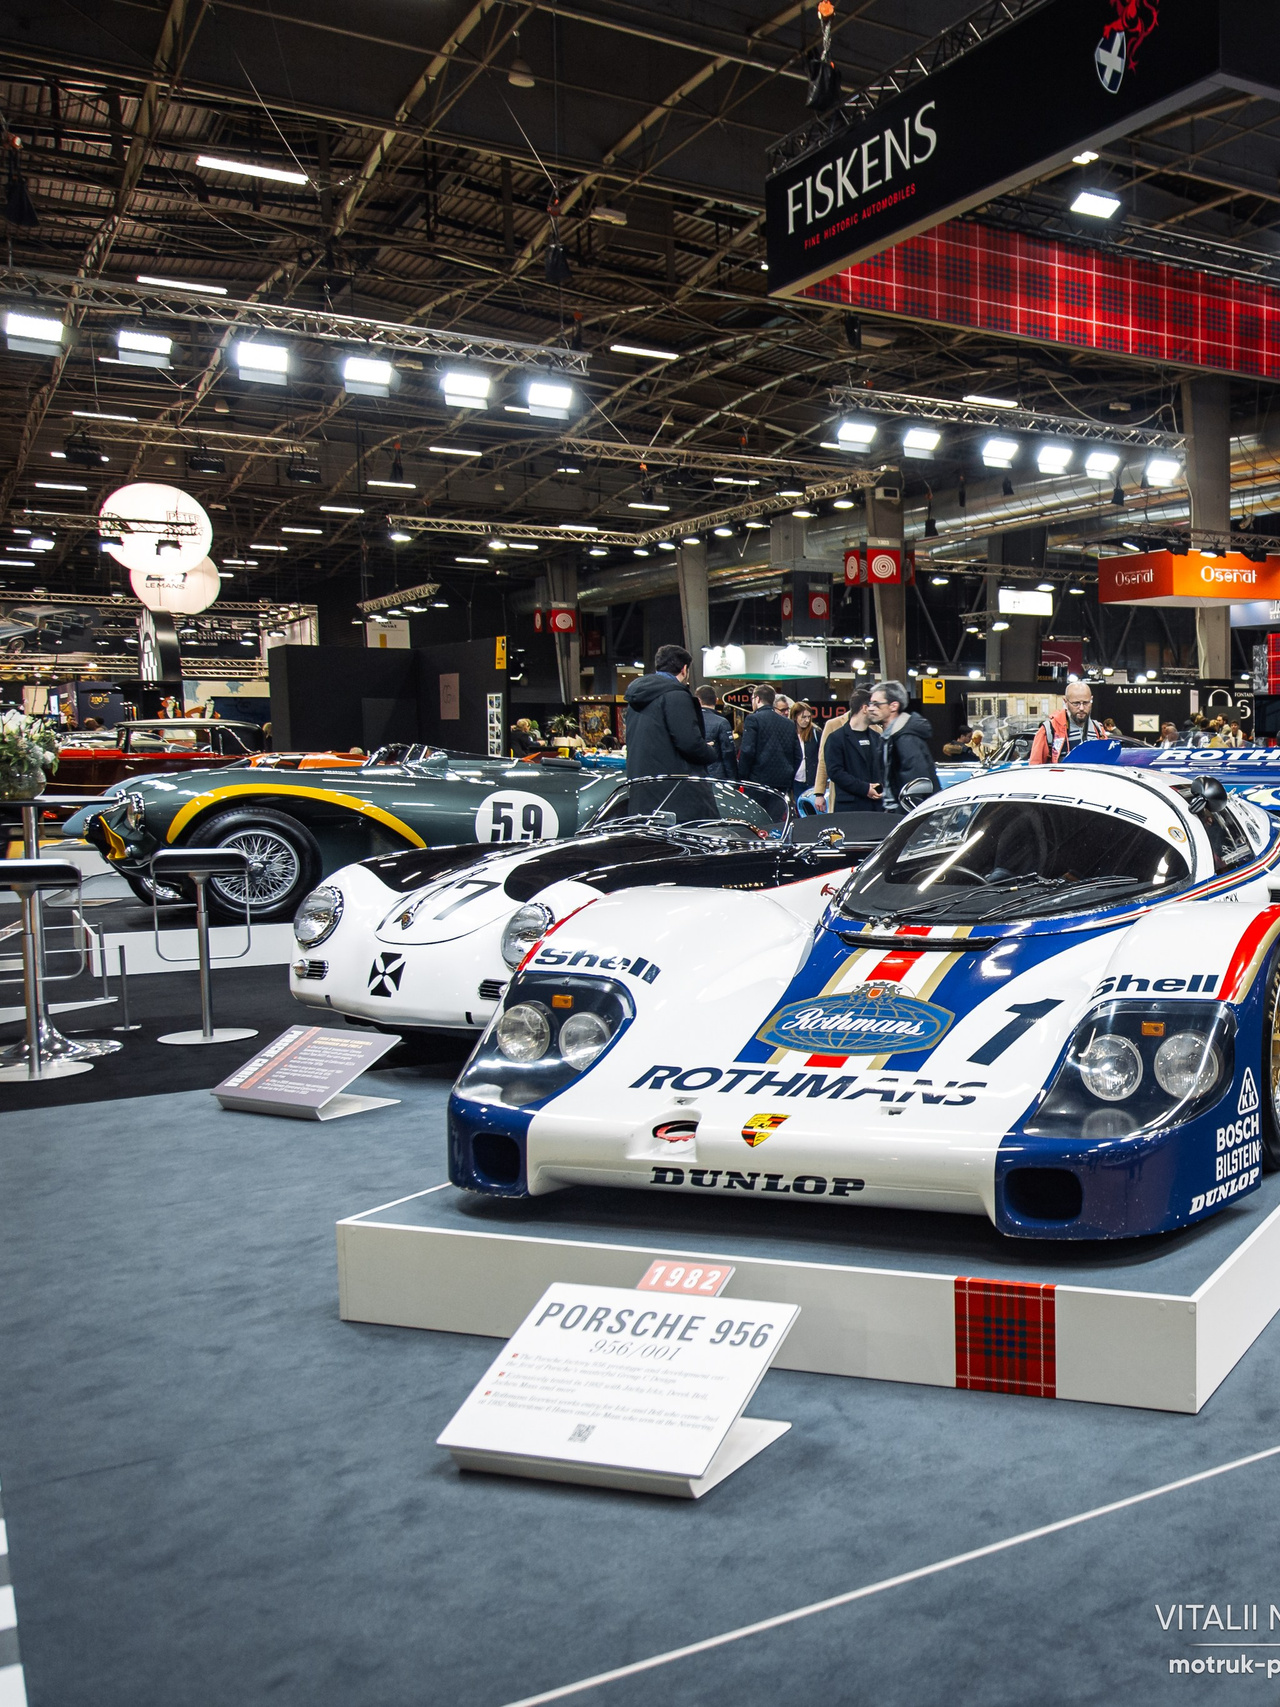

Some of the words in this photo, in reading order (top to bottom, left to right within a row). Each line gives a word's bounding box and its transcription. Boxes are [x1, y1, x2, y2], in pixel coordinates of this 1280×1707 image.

[787, 100, 938, 235] FISKENS
[804, 233, 820, 250] FINE
[824, 213, 859, 239] HISTORIC
[862, 183, 916, 220] AUTOMOBILES
[1115, 568, 1154, 586] Osenat
[1200, 565, 1257, 583] Osenat
[1116, 686, 1152, 694] Auction
[1155, 686, 1181, 694] house
[491, 801, 544, 842] 59
[534, 948, 661, 985] Shell
[1089, 974, 1220, 999] Shell
[781, 1007, 926, 1036] Rothmans
[967, 998, 1066, 1066] 1
[628, 1065, 988, 1106] ROTHMANS
[1216, 1113, 1260, 1152] BOSCH
[1216, 1140, 1260, 1181] BILSTEIN
[650, 1166, 865, 1197] DUNLOP
[1189, 1167, 1260, 1215] DUNLOP
[651, 1264, 722, 1291] 1982
[535, 1302, 706, 1342] PORSCHE
[710, 1319, 774, 1349] 956
[589, 1339, 683, 1361] 956/001
